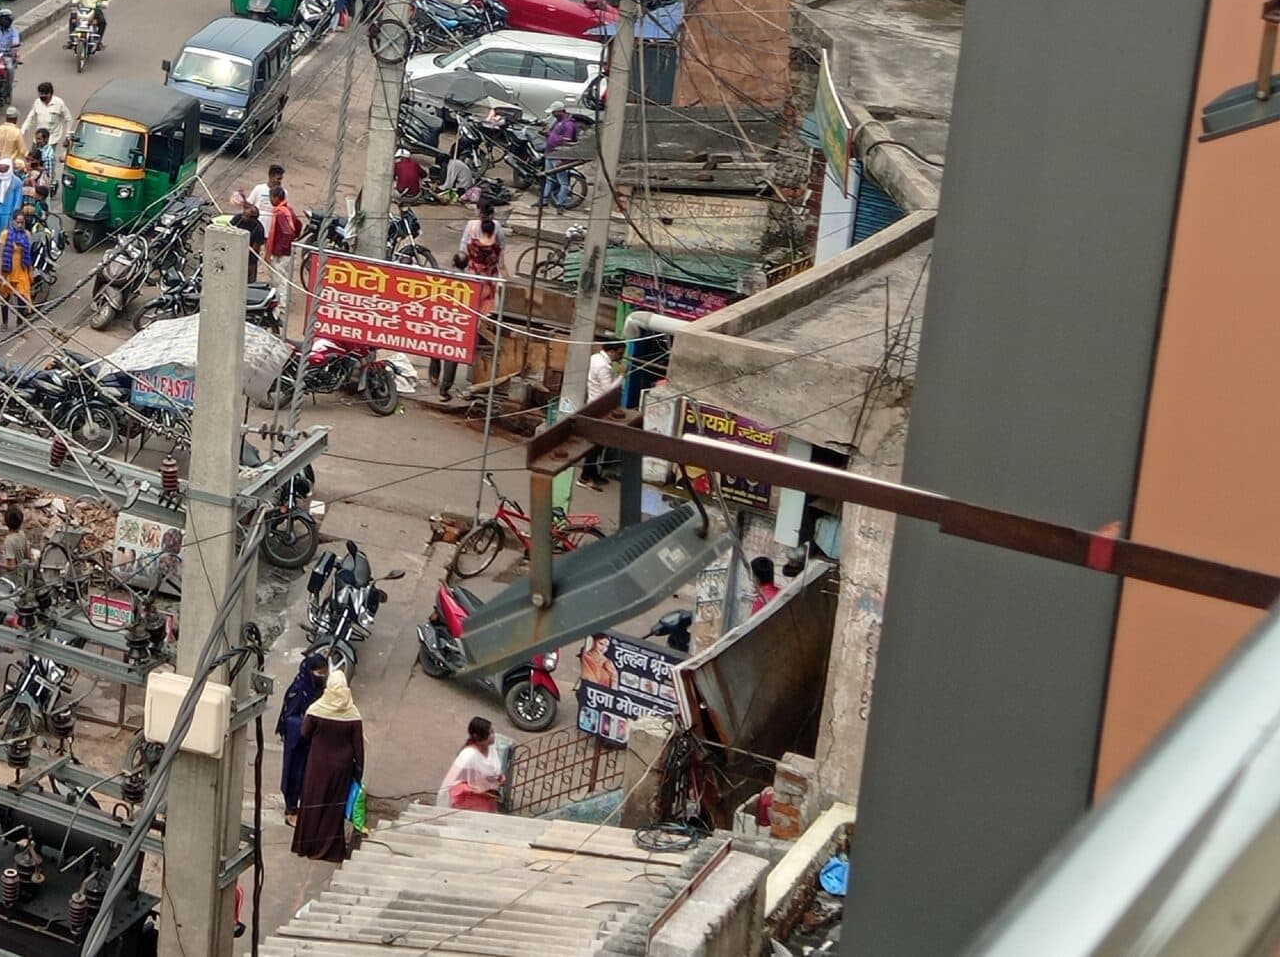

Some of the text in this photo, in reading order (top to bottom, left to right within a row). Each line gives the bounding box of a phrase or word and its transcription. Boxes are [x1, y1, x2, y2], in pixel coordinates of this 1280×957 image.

[396, 275, 474, 307] कॉपी
[432, 305, 472, 327] प्रिंट
[313, 321, 467, 359] PAPER LAMINATION
[405, 320, 466, 342] फोटो
[614, 646, 649, 671] दुल्हन
